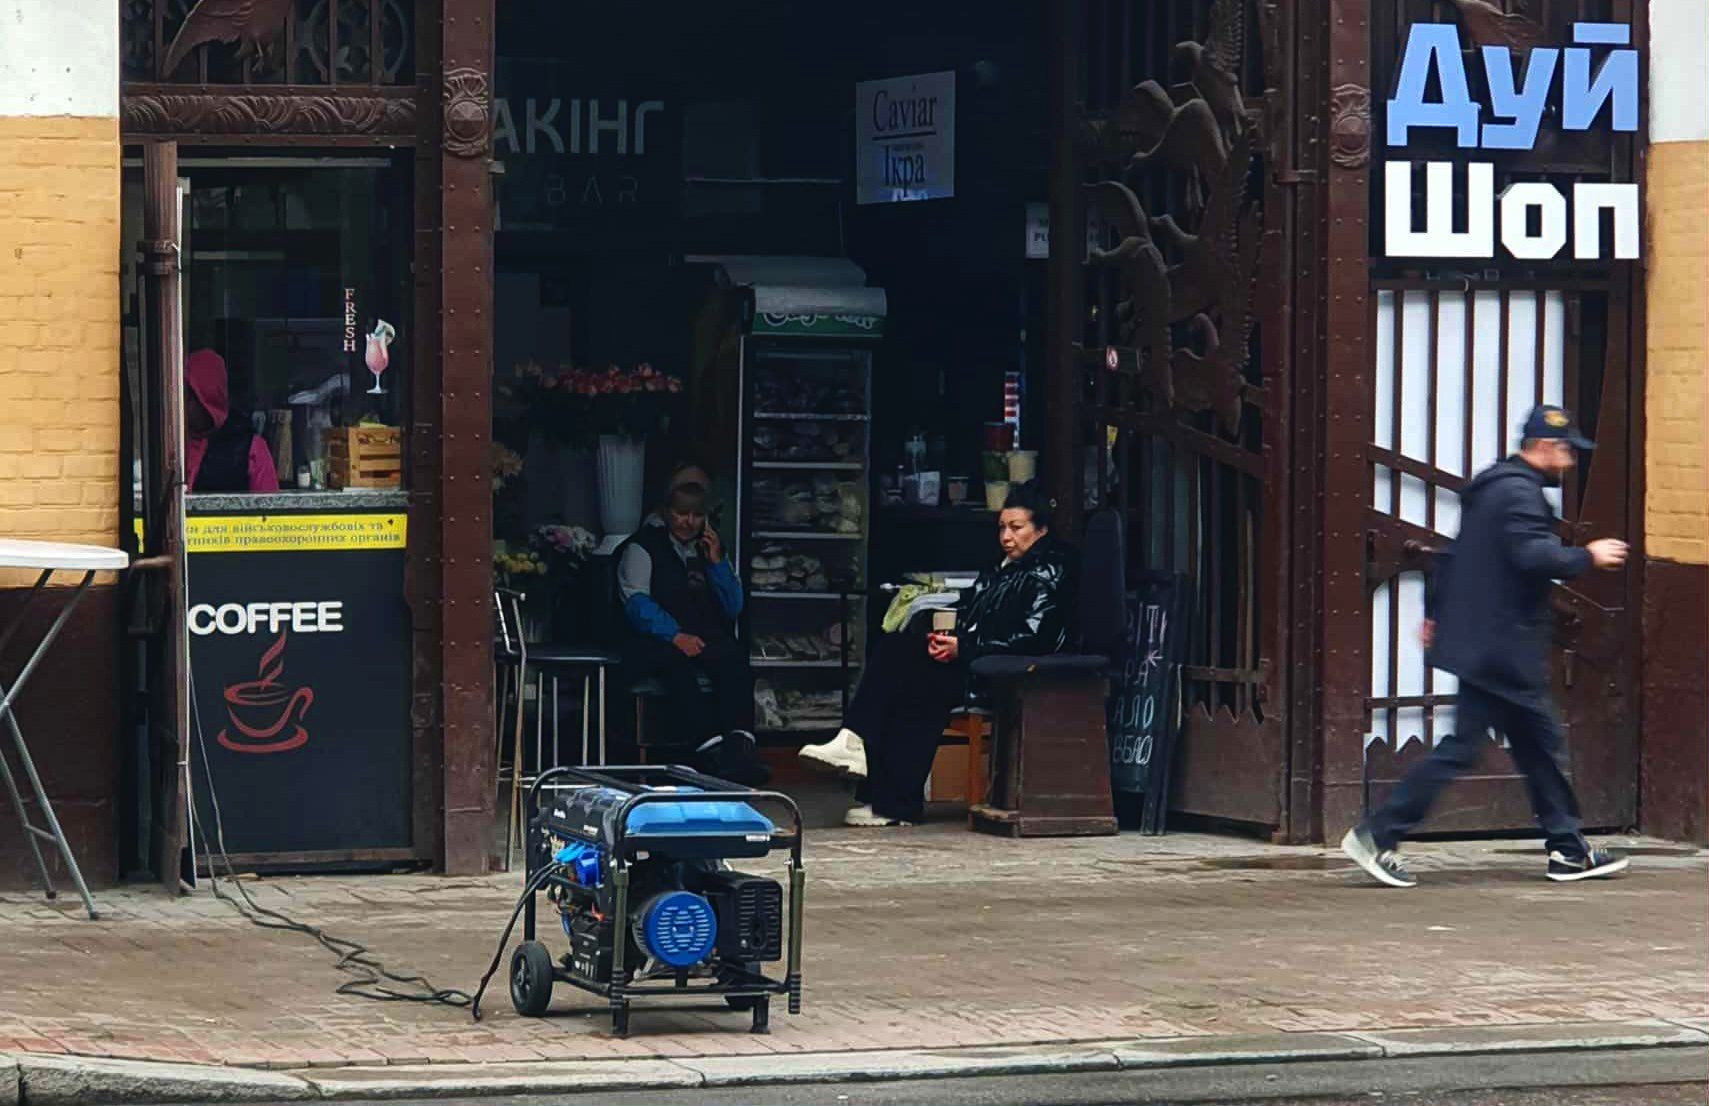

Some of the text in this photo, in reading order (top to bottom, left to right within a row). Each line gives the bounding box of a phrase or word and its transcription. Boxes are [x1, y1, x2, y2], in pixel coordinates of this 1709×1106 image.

[872, 86, 937, 132] Caviar
[1386, 22, 1638, 150] Дуй
[546, 174, 641, 206] BAR
[884, 145, 925, 198] Ікра
[1385, 160, 1640, 259] Шоп
[343, 288, 357, 352] FRESH
[370, 522, 383, 531] та
[188, 601, 343, 636] COFFEE
